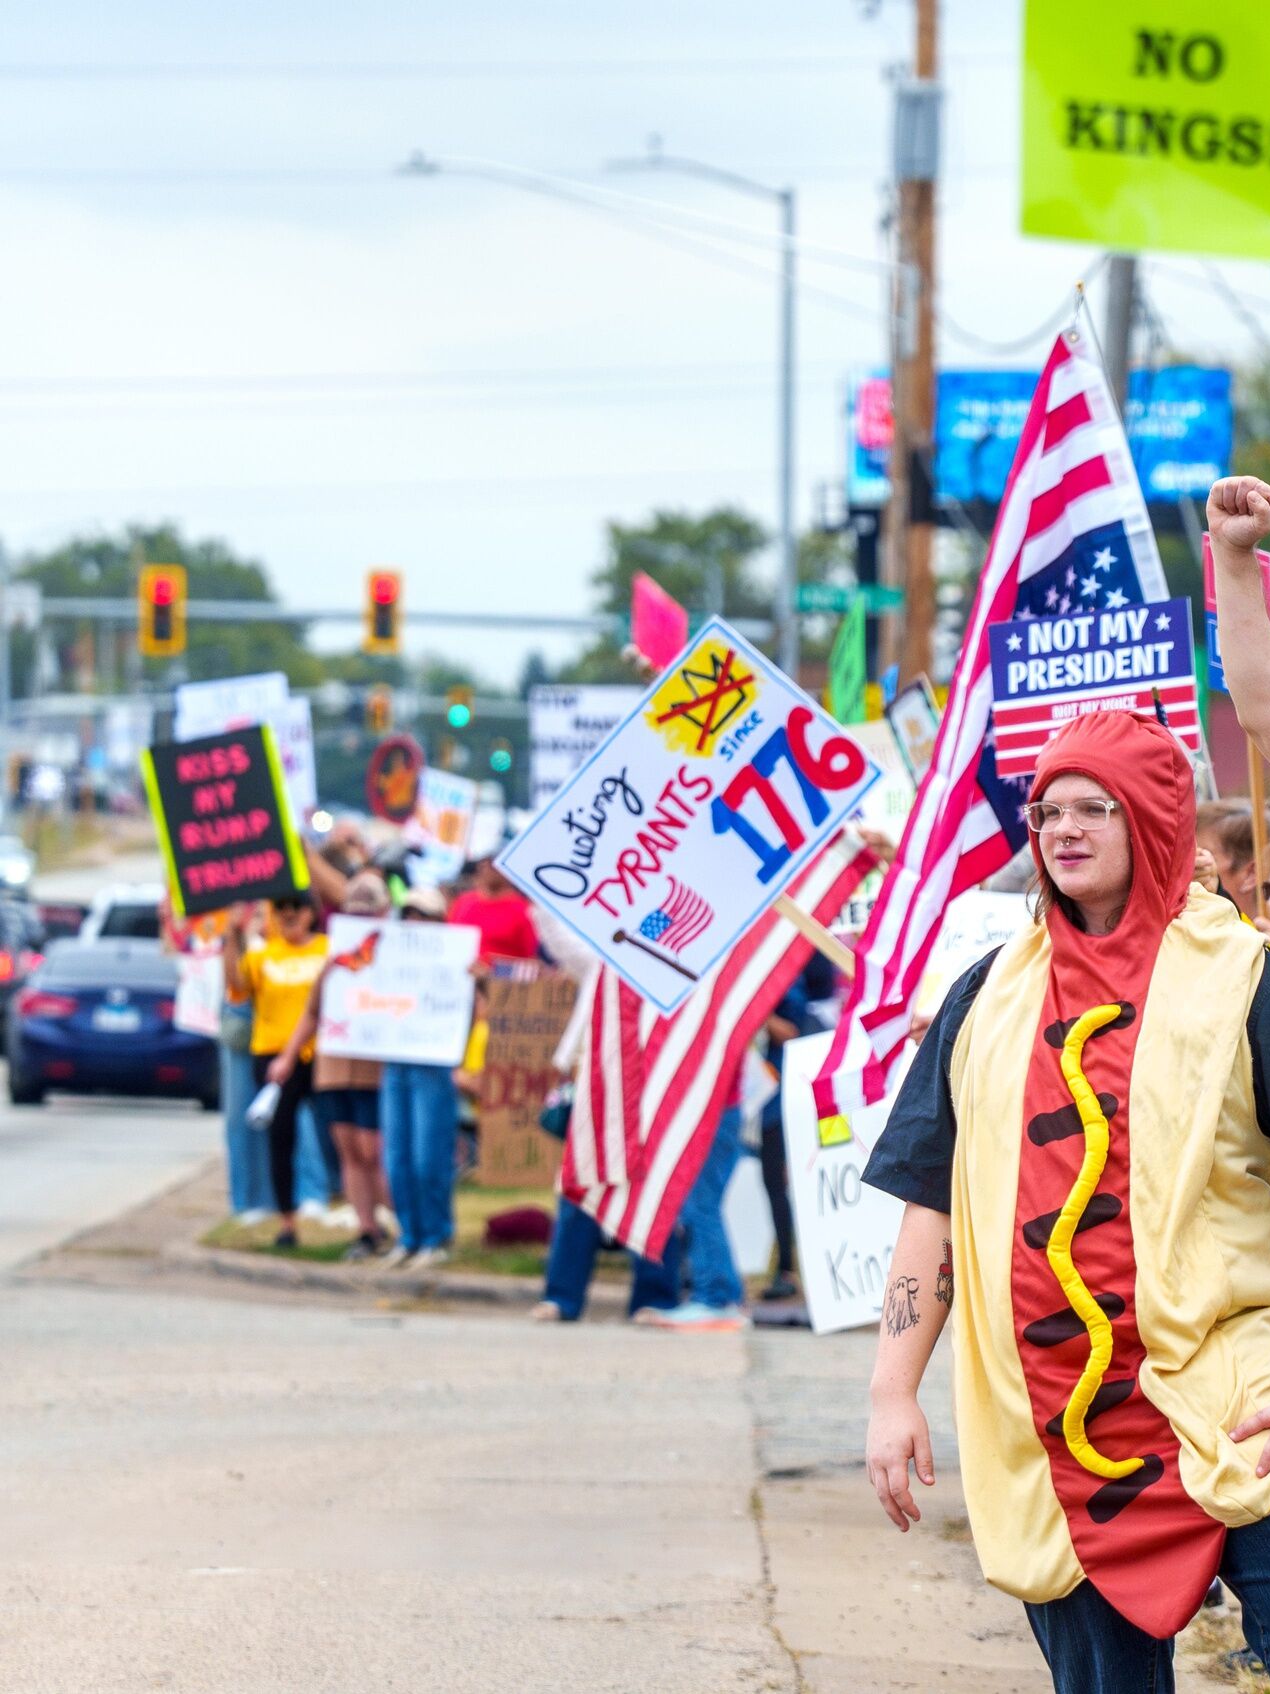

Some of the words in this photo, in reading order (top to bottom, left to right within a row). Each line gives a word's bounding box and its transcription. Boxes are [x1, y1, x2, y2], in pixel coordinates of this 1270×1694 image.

[1133, 26, 1226, 84] NO
[1027, 615, 1095, 656] NOT
[1100, 597, 1150, 646] MY
[1008, 641, 1175, 695] PRESIDENT
[716, 709, 765, 762] since
[1052, 702, 1079, 720] NOT
[175, 744, 250, 782] KISS
[711, 705, 867, 886] 1776
[180, 808, 270, 850] RUMP
[583, 763, 714, 918] TYRANTS
[184, 850, 284, 893] TRUMP
[817, 1163, 863, 1217] NO
[825, 1240, 893, 1302] Kin
